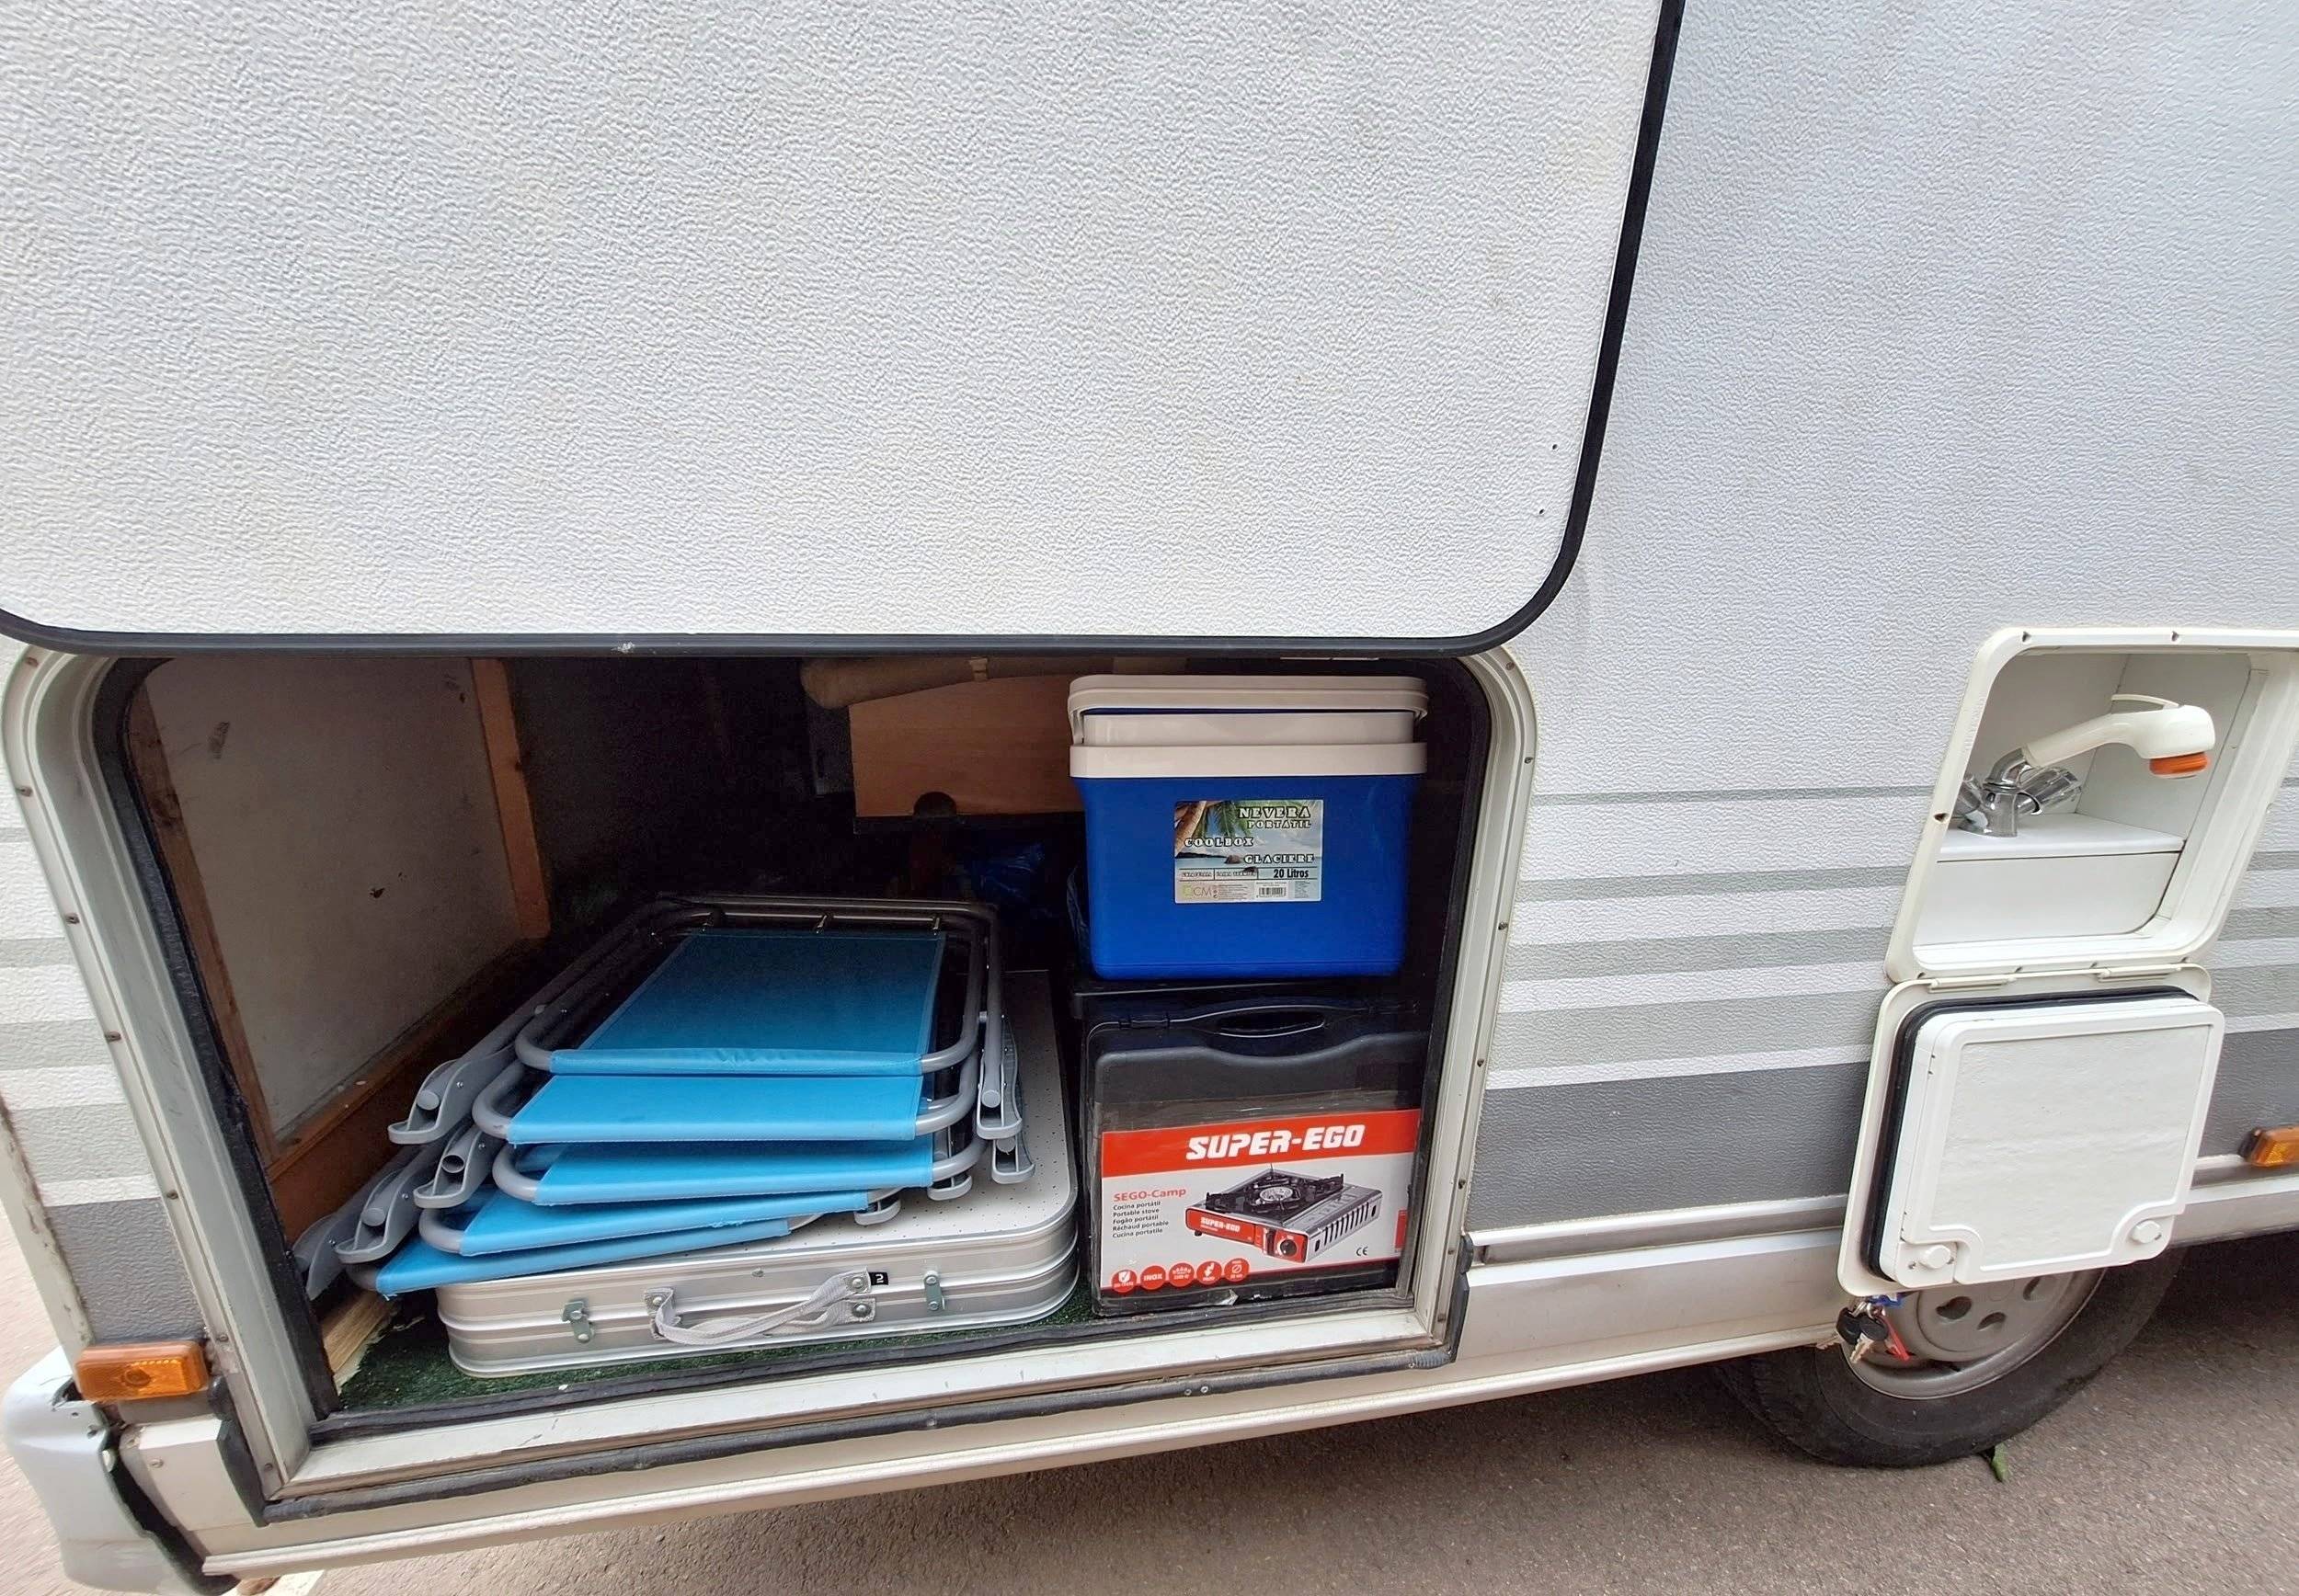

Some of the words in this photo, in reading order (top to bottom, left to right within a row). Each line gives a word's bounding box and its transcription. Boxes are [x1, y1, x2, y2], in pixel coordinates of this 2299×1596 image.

[1239, 805, 1311, 819] NEVERA
[1184, 837, 1254, 848] COOLBOX
[1244, 853, 1315, 865] GLACIERE
[1274, 869, 1285, 879] 20
[1287, 868, 1310, 879] Litros
[1185, 1123, 1366, 1160] SUPER-EGO
[1114, 1188, 1186, 1202] SEGO-Camp
[1113, 1210, 1140, 1218] Portable
[1141, 1207, 1161, 1215] stove
[1141, 1219, 1170, 1229] portable
[1200, 1216, 1241, 1233] SUPER-EGO
[1112, 1229, 1134, 1238] Cucina
[1135, 1226, 1163, 1237] portatile
[875, 1273, 884, 1283] 2
[1143, 1272, 1163, 1282] INOX
